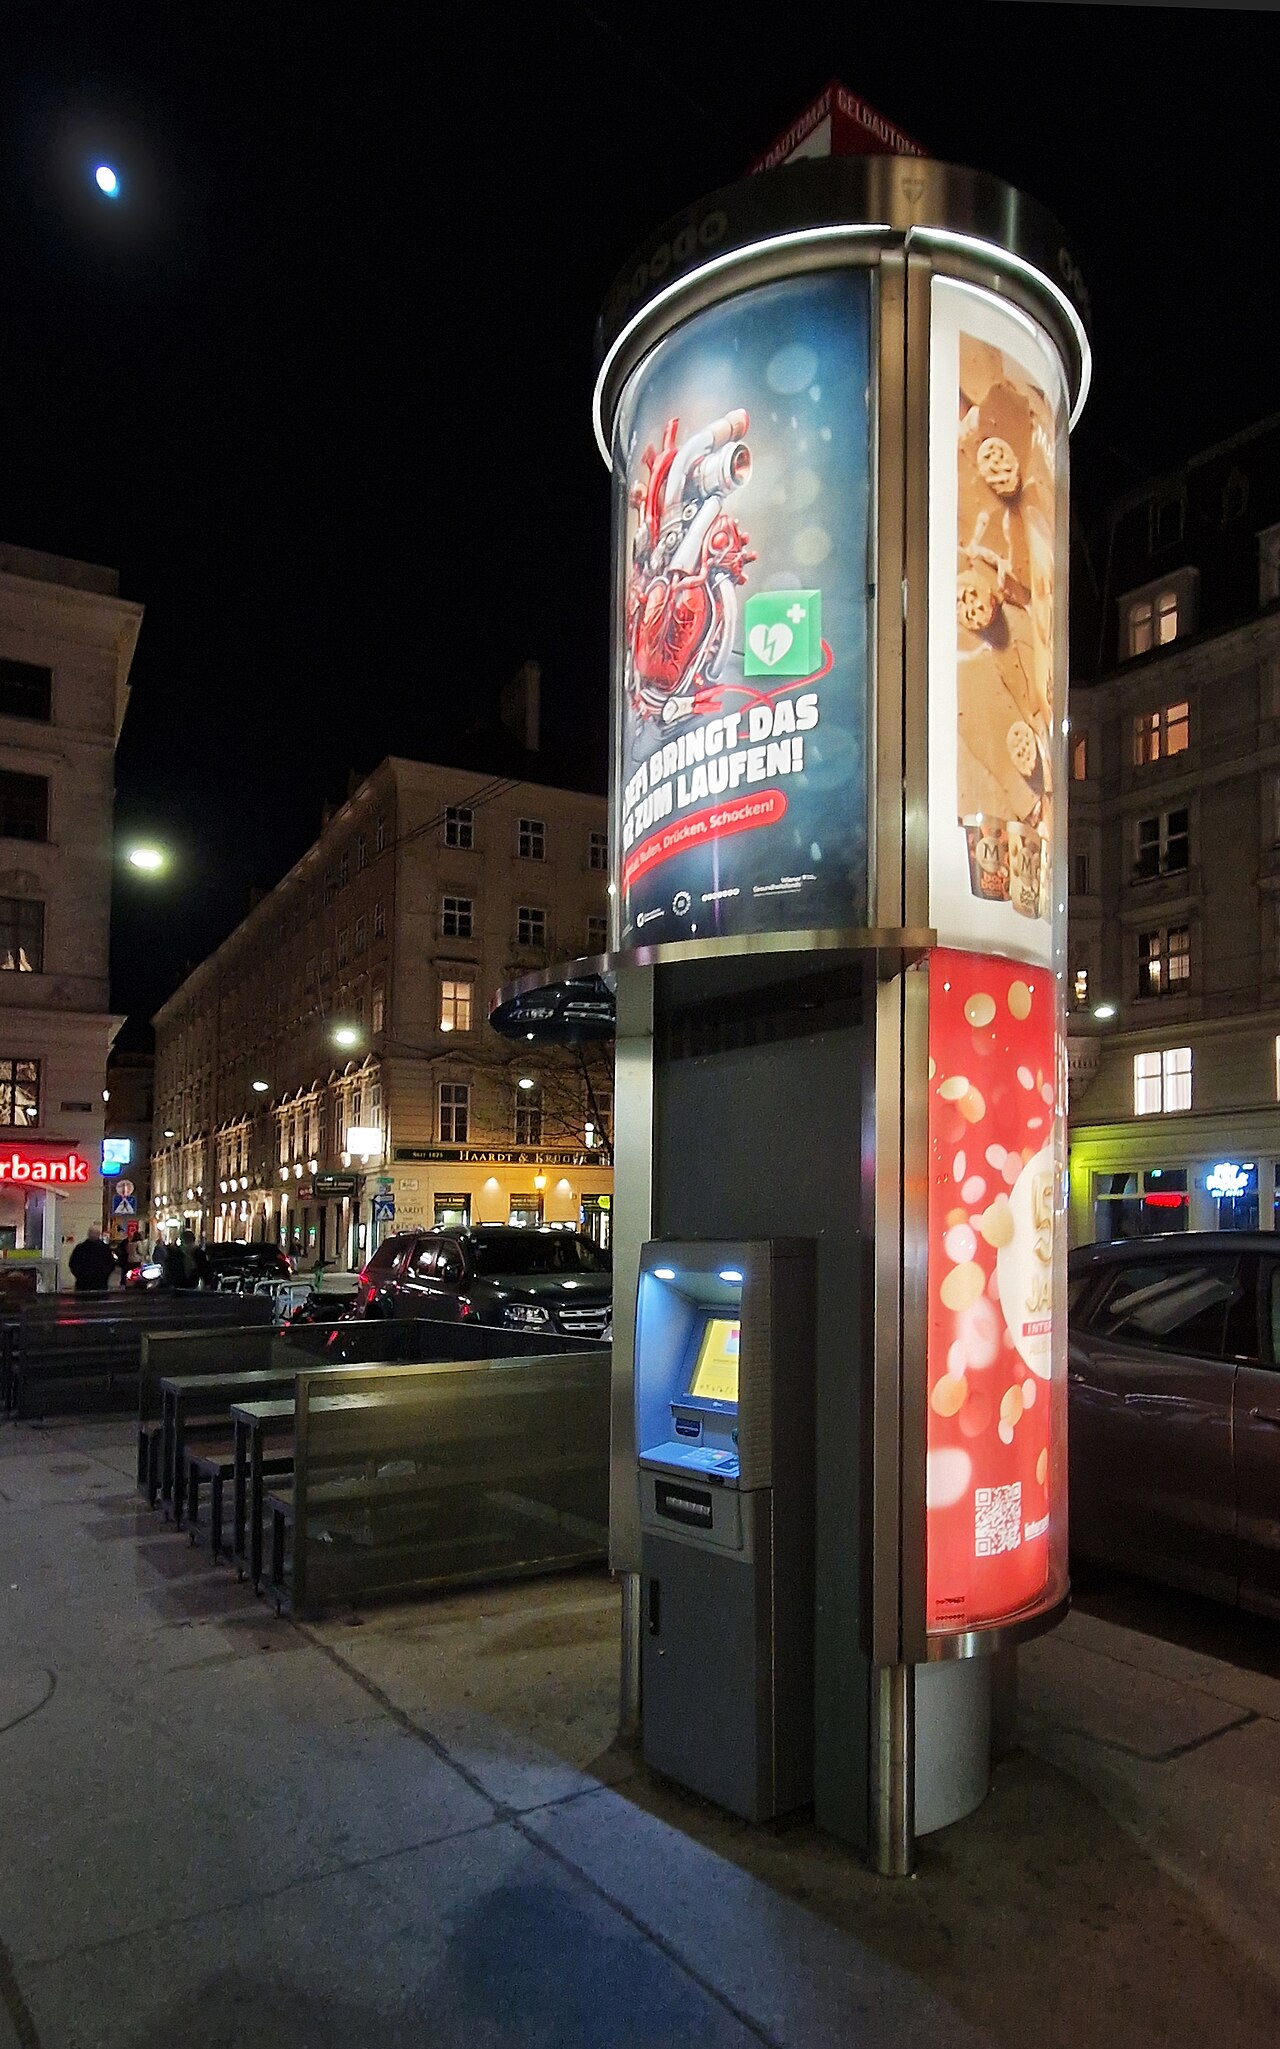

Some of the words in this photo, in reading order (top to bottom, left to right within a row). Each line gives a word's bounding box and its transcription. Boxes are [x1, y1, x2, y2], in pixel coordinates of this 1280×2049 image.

[650, 712, 741, 787] BRINGT
[750, 693, 819, 743] DAS
[635, 780, 673, 838] ZUM
[677, 736, 804, 809] LAUFEN!
[663, 818, 708, 849] Drücken,
[709, 798, 775, 830] Schocken!
[459, 1150, 512, 1163] HAARDT
[518, 1152, 530, 1163] &
[395, 1206, 424, 1216] AARDT
